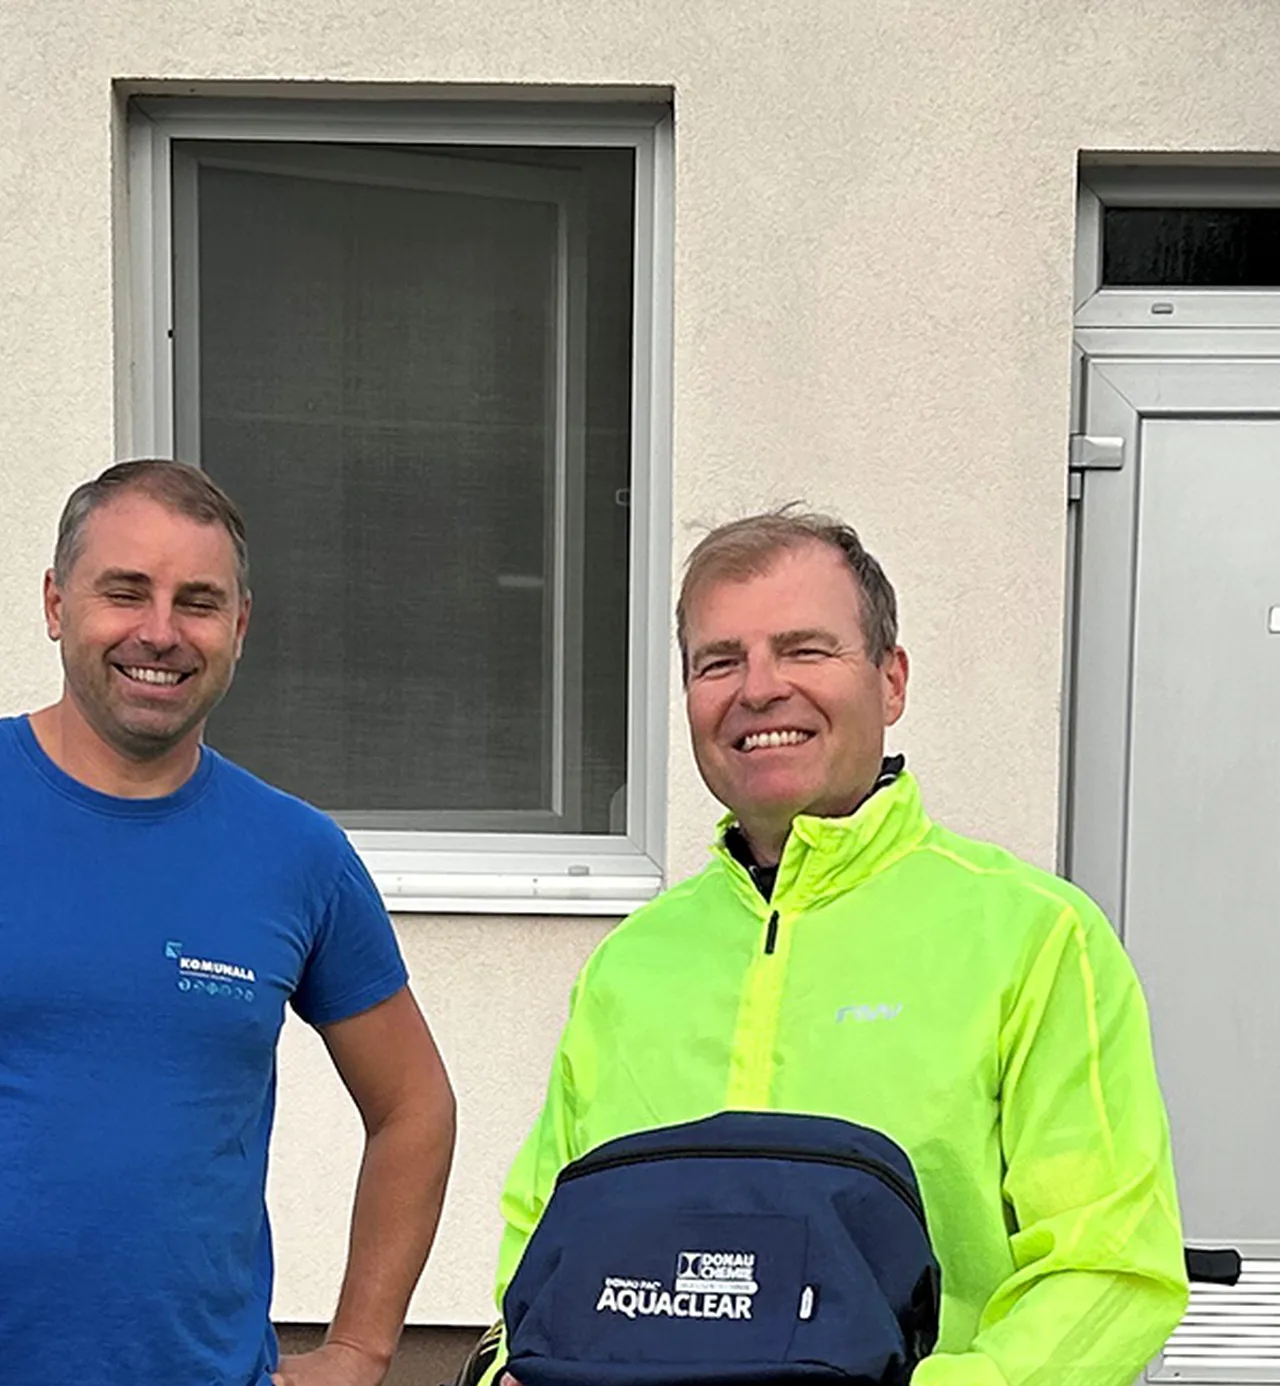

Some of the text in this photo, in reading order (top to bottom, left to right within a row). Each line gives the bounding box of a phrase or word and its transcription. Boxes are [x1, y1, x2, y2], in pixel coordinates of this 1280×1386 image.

[180, 957, 255, 982] KOMUNALA
[702, 1253, 755, 1267] DONAU
[596, 1287, 752, 1319] AQUACLEAR
